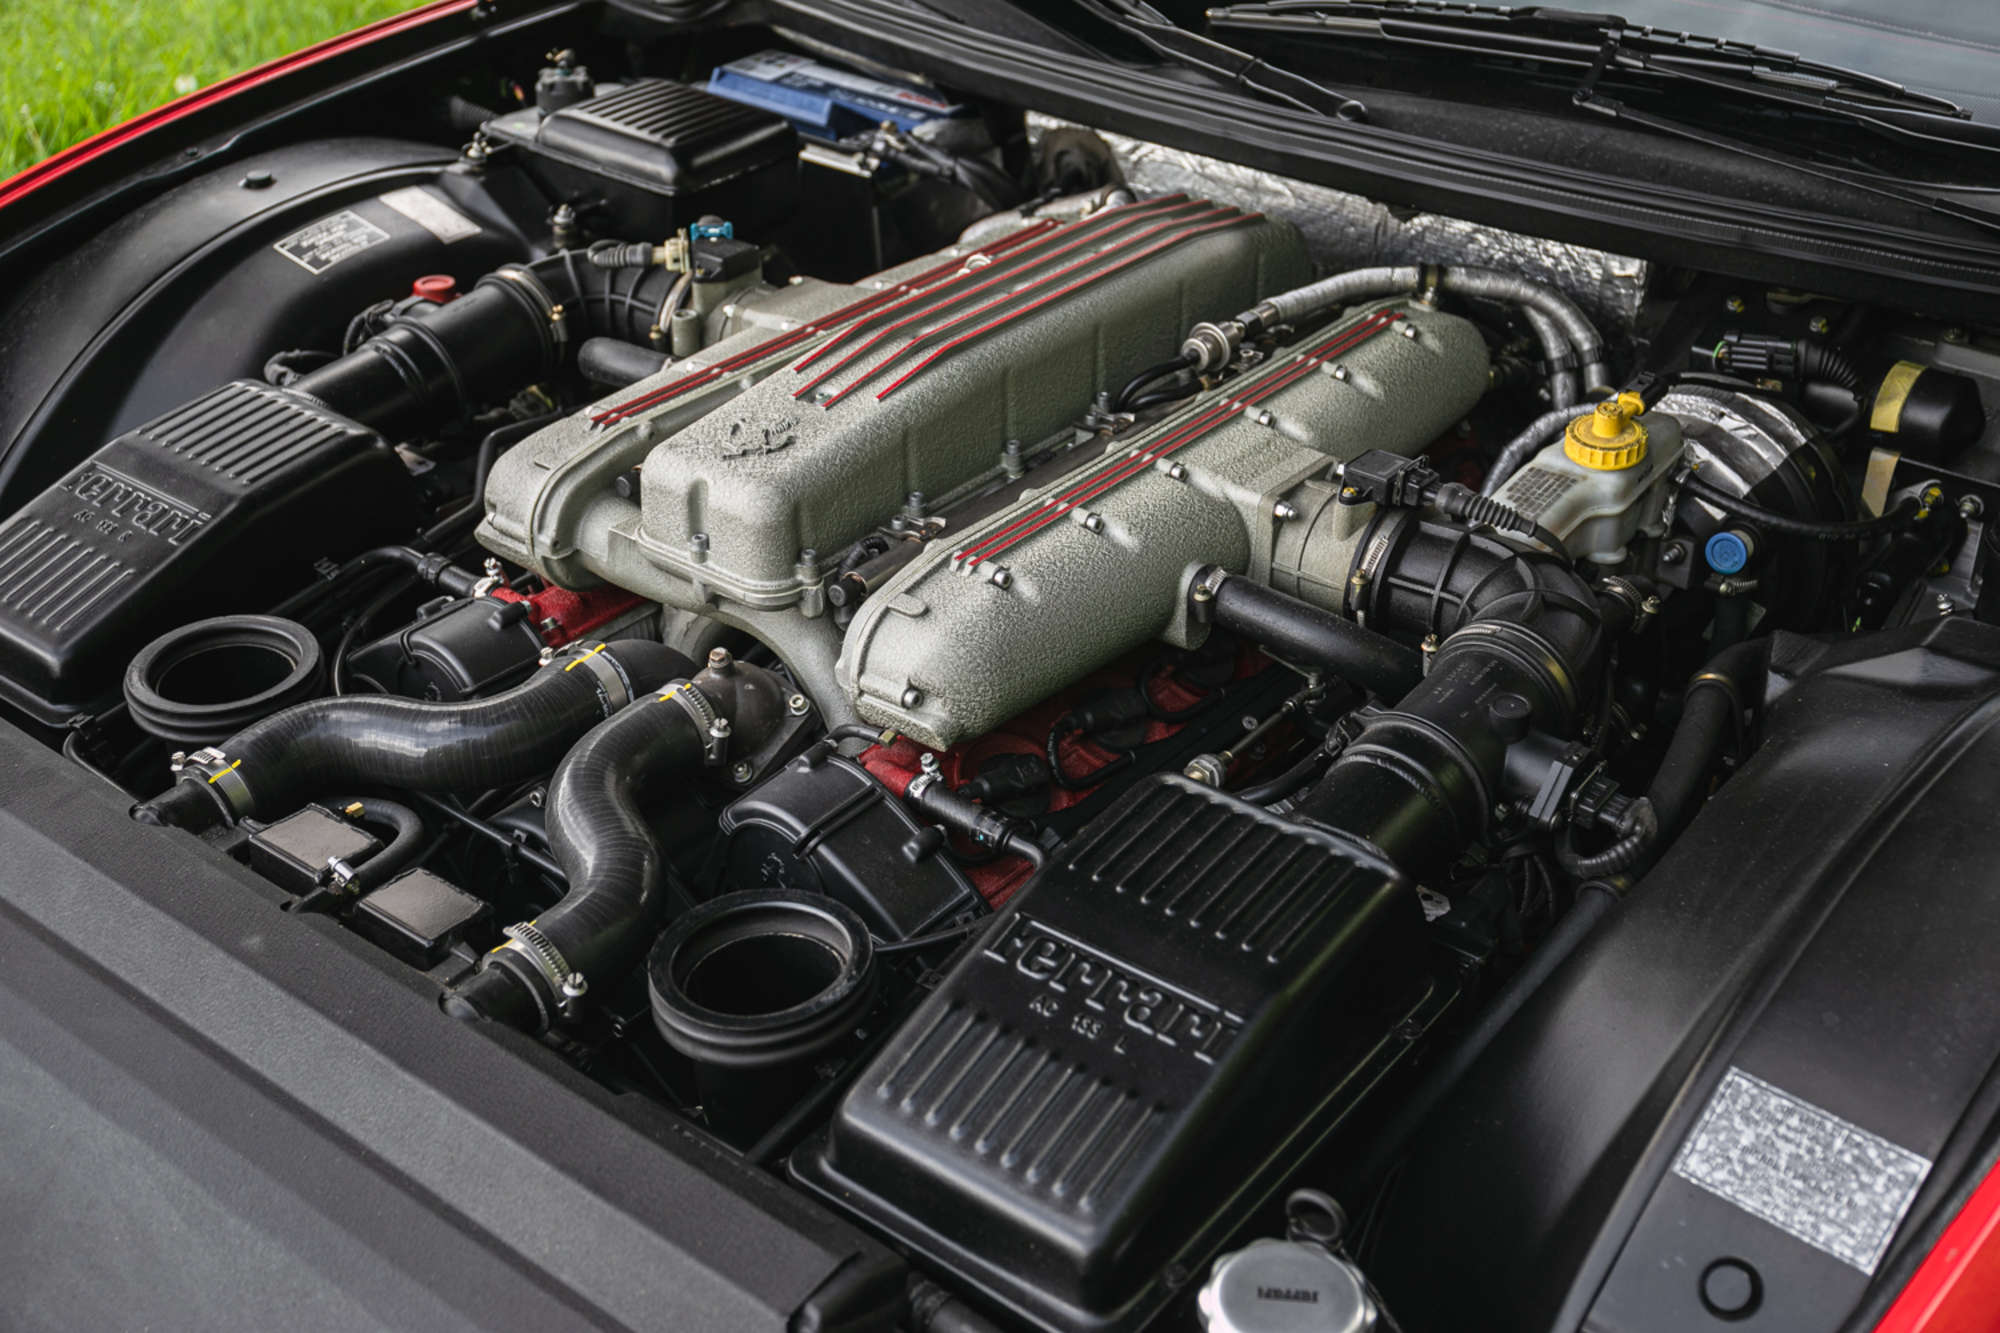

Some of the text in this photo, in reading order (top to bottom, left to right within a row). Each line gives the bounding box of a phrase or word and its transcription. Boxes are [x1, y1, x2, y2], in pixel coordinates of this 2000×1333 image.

[57, 460, 211, 546] Ferrari
[984, 912, 1244, 1064] Ferrari
[1029, 994, 1058, 1017] AC
[1114, 1035, 1126, 1054] L
